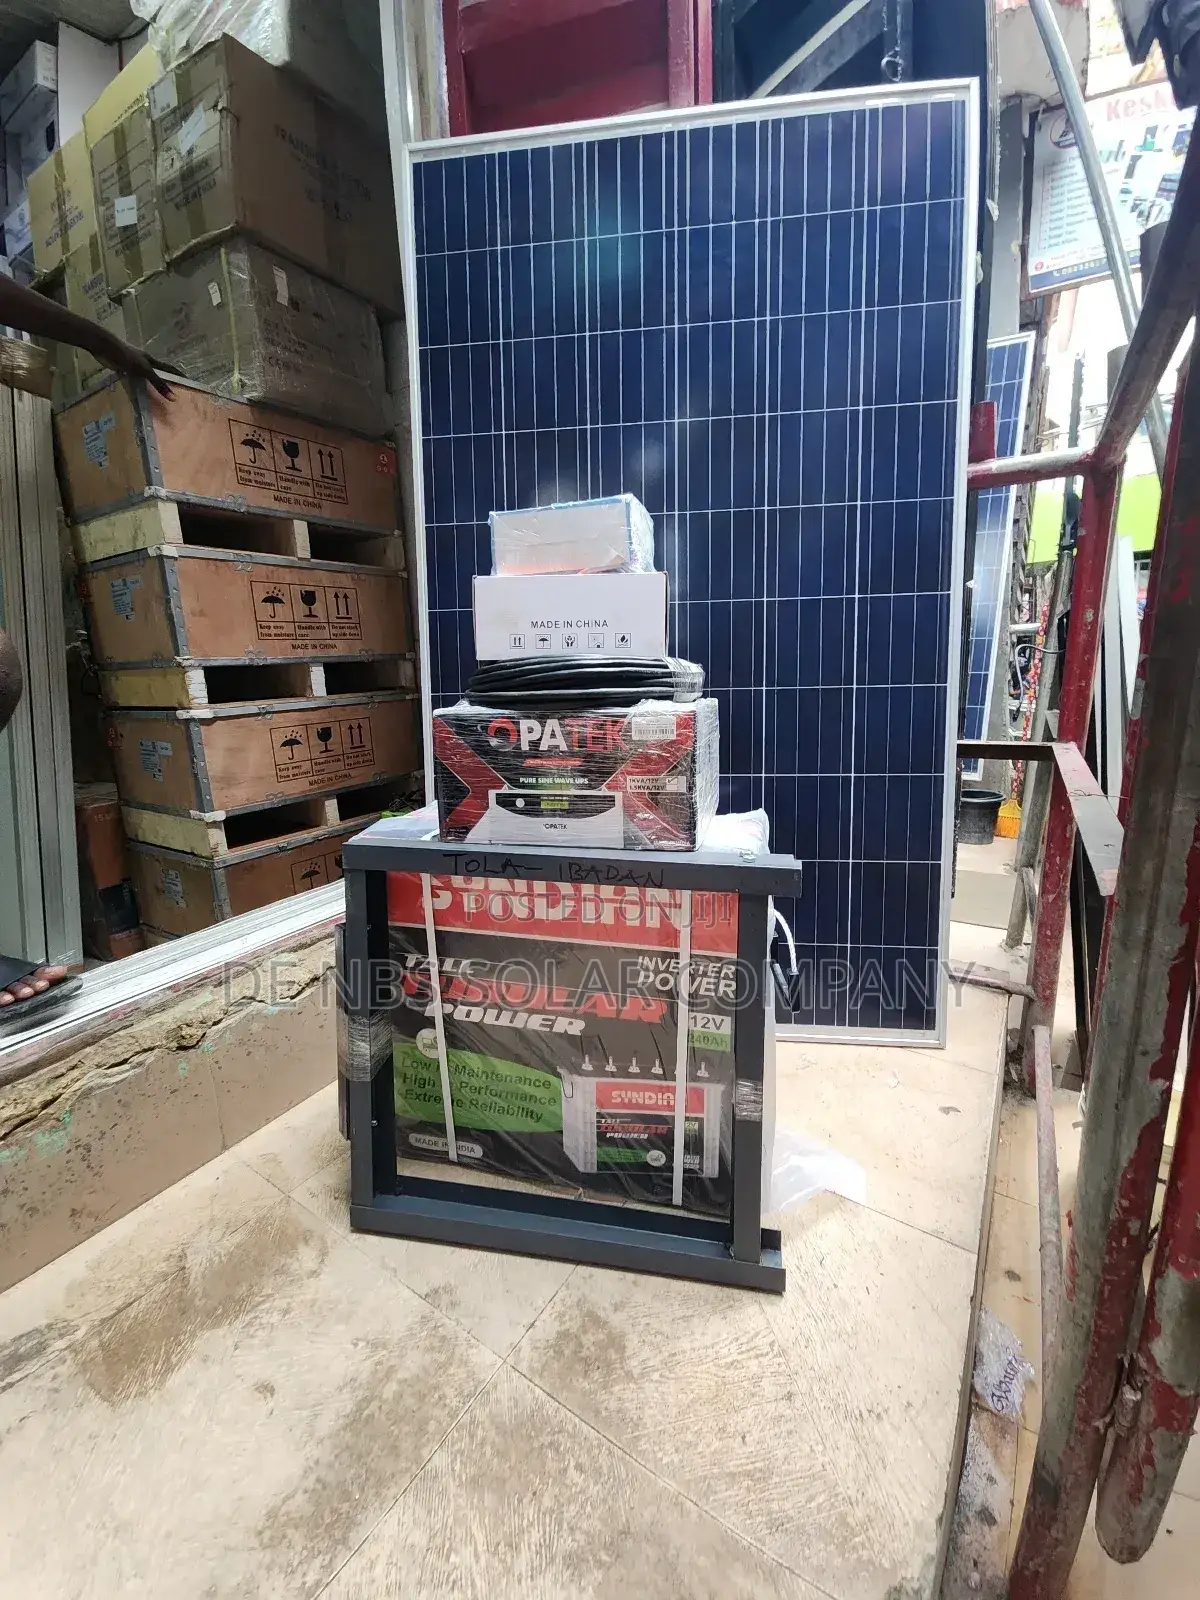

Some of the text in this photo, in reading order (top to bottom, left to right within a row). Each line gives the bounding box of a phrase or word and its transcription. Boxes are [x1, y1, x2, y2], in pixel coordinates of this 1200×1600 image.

[273, 494, 323, 509] MADE IN CHINA
[531, 619, 609, 629] MADE IN CHINA
[487, 716, 630, 751] OPATEK
[308, 779, 327, 787] MADE
[334, 773, 352, 781] CHINA
[537, 777, 554, 785] SINE
[559, 861, 665, 888] IBADAN
[424, 1001, 586, 1036] POWER
[690, 1014, 725, 1031] 12V
[402, 1056, 431, 1071] Low
[454, 1063, 552, 1089] Maintenance
[403, 1072, 557, 1107] High Performance
[611, 1090, 687, 1106] SYNDIA
[404, 1089, 544, 1123] Extree Reliability
[414, 1137, 440, 1148] MADE
